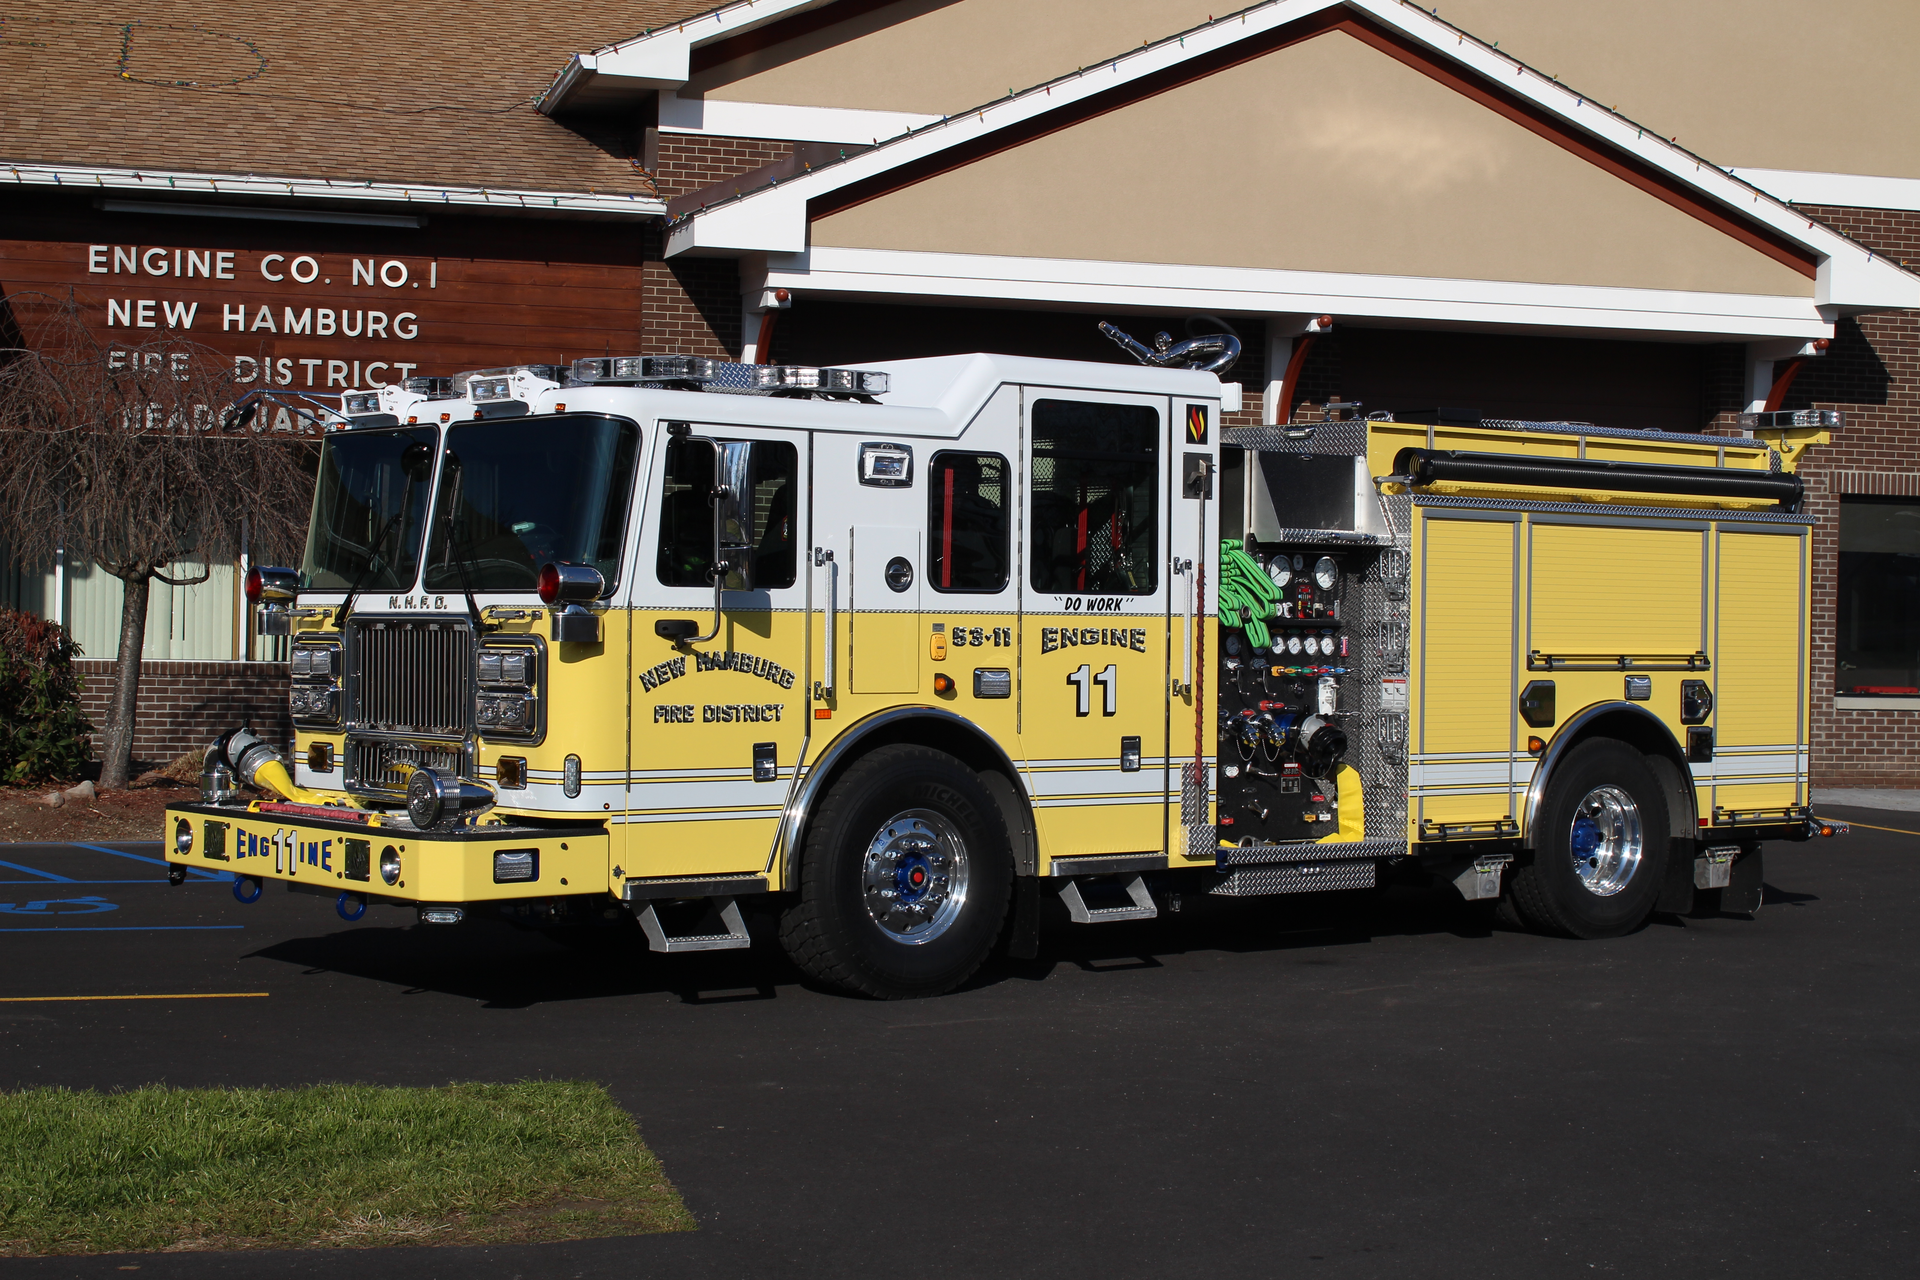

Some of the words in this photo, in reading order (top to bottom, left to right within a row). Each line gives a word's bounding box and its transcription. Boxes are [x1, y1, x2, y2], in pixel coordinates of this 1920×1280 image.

[88, 245, 236, 280] ENGINE
[260, 253, 331, 285] CO.
[107, 298, 198, 330] NEW
[223, 303, 418, 340] HAMBURG
[107, 350, 190, 382] FIRE
[234, 354, 418, 390] DISTRICT
[1041, 626, 1147, 655] ENGINE
[638, 654, 688, 694] NEW
[695, 650, 797, 690] HAMBURG
[1066, 663, 1117, 718] 11
[653, 704, 695, 724] FIRE
[702, 703, 785, 723] DISTRICT
